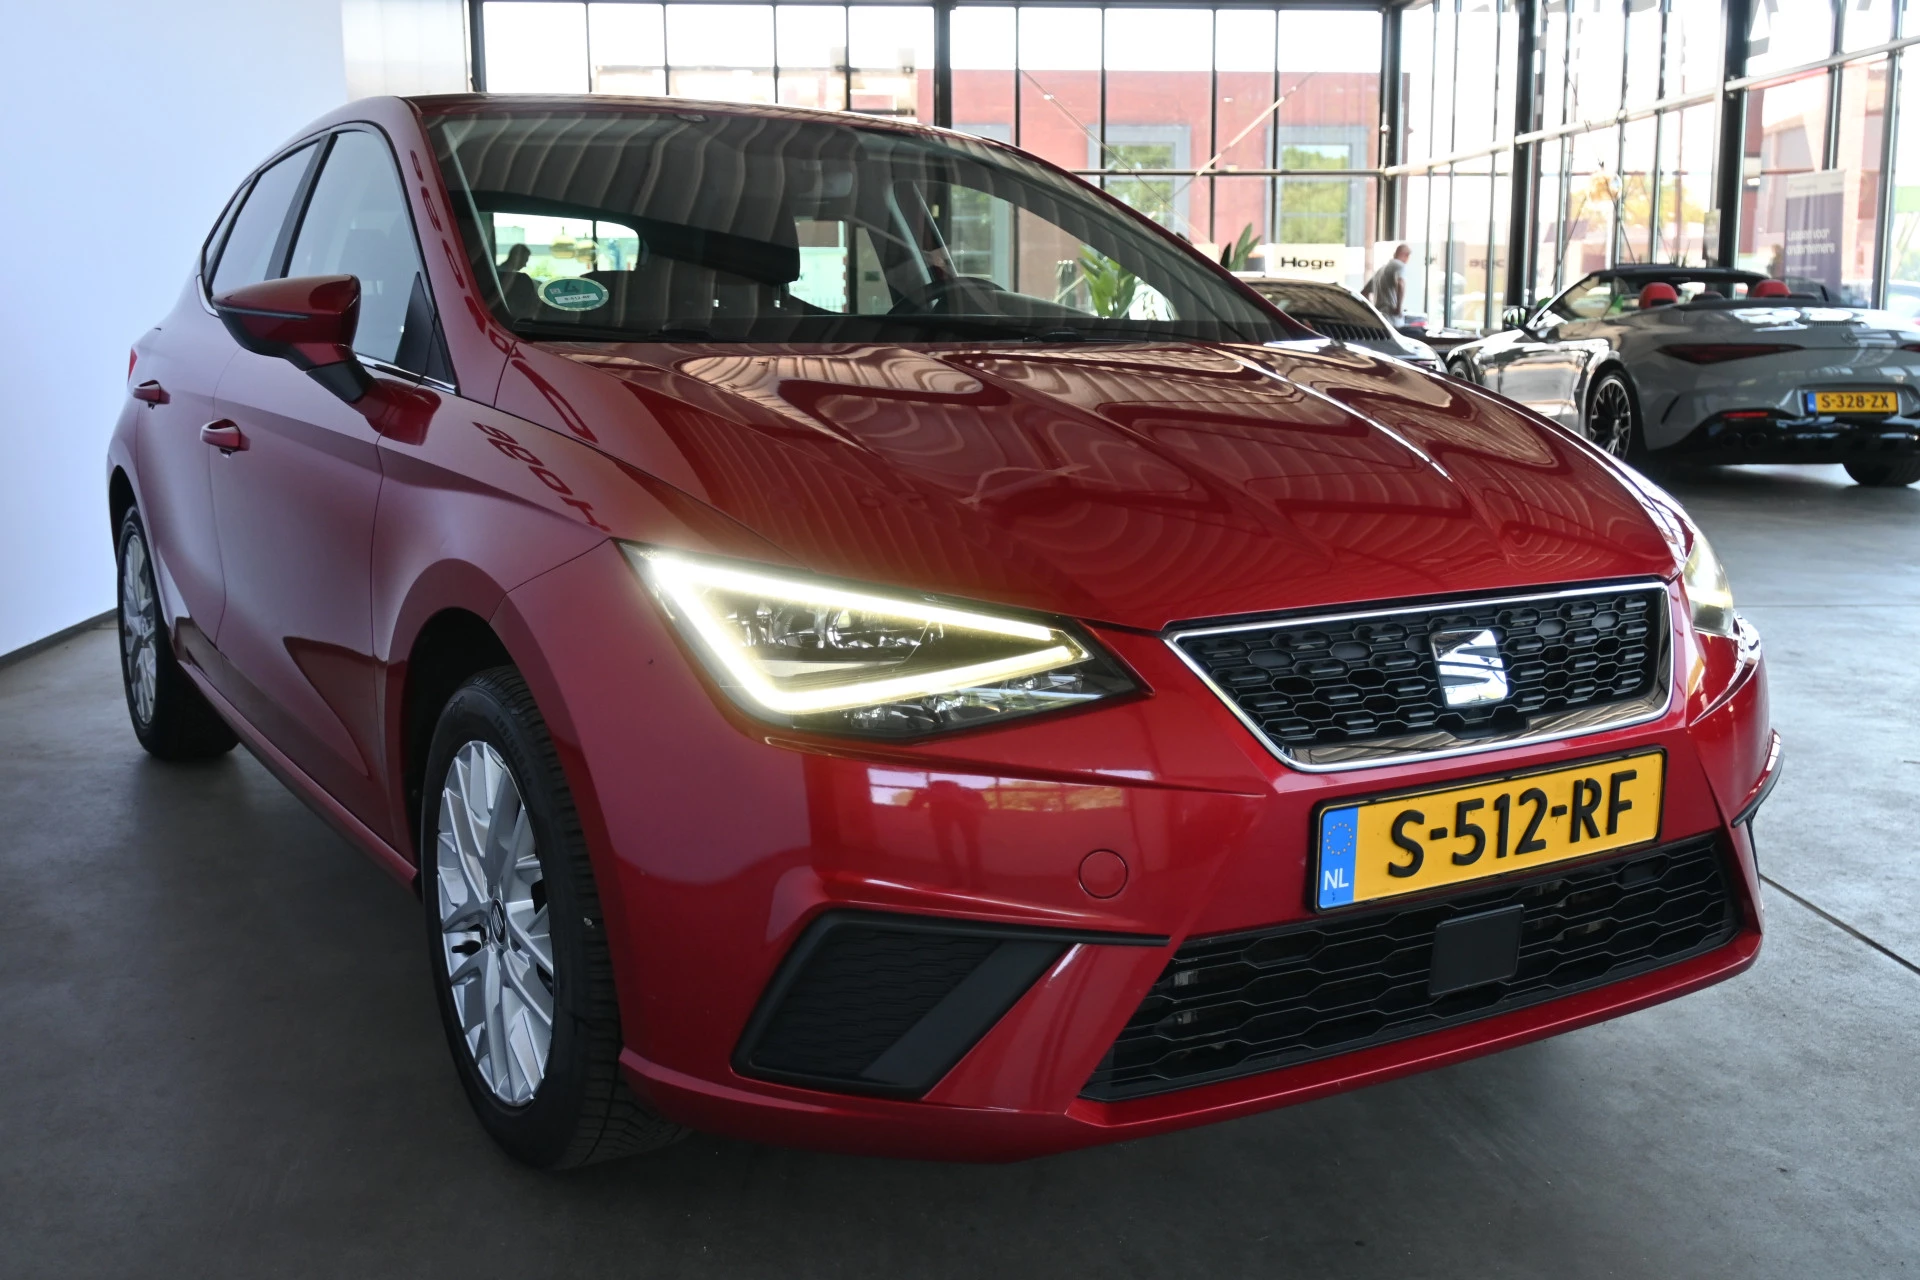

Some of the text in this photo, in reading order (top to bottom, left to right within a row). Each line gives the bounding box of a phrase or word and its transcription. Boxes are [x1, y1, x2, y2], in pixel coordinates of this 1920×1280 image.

[1281, 256, 1334, 270] Hoge
[1821, 394, 1889, 409] S-328-ZX
[1388, 769, 1637, 878] S-512-RF
[1323, 868, 1350, 891] NL
